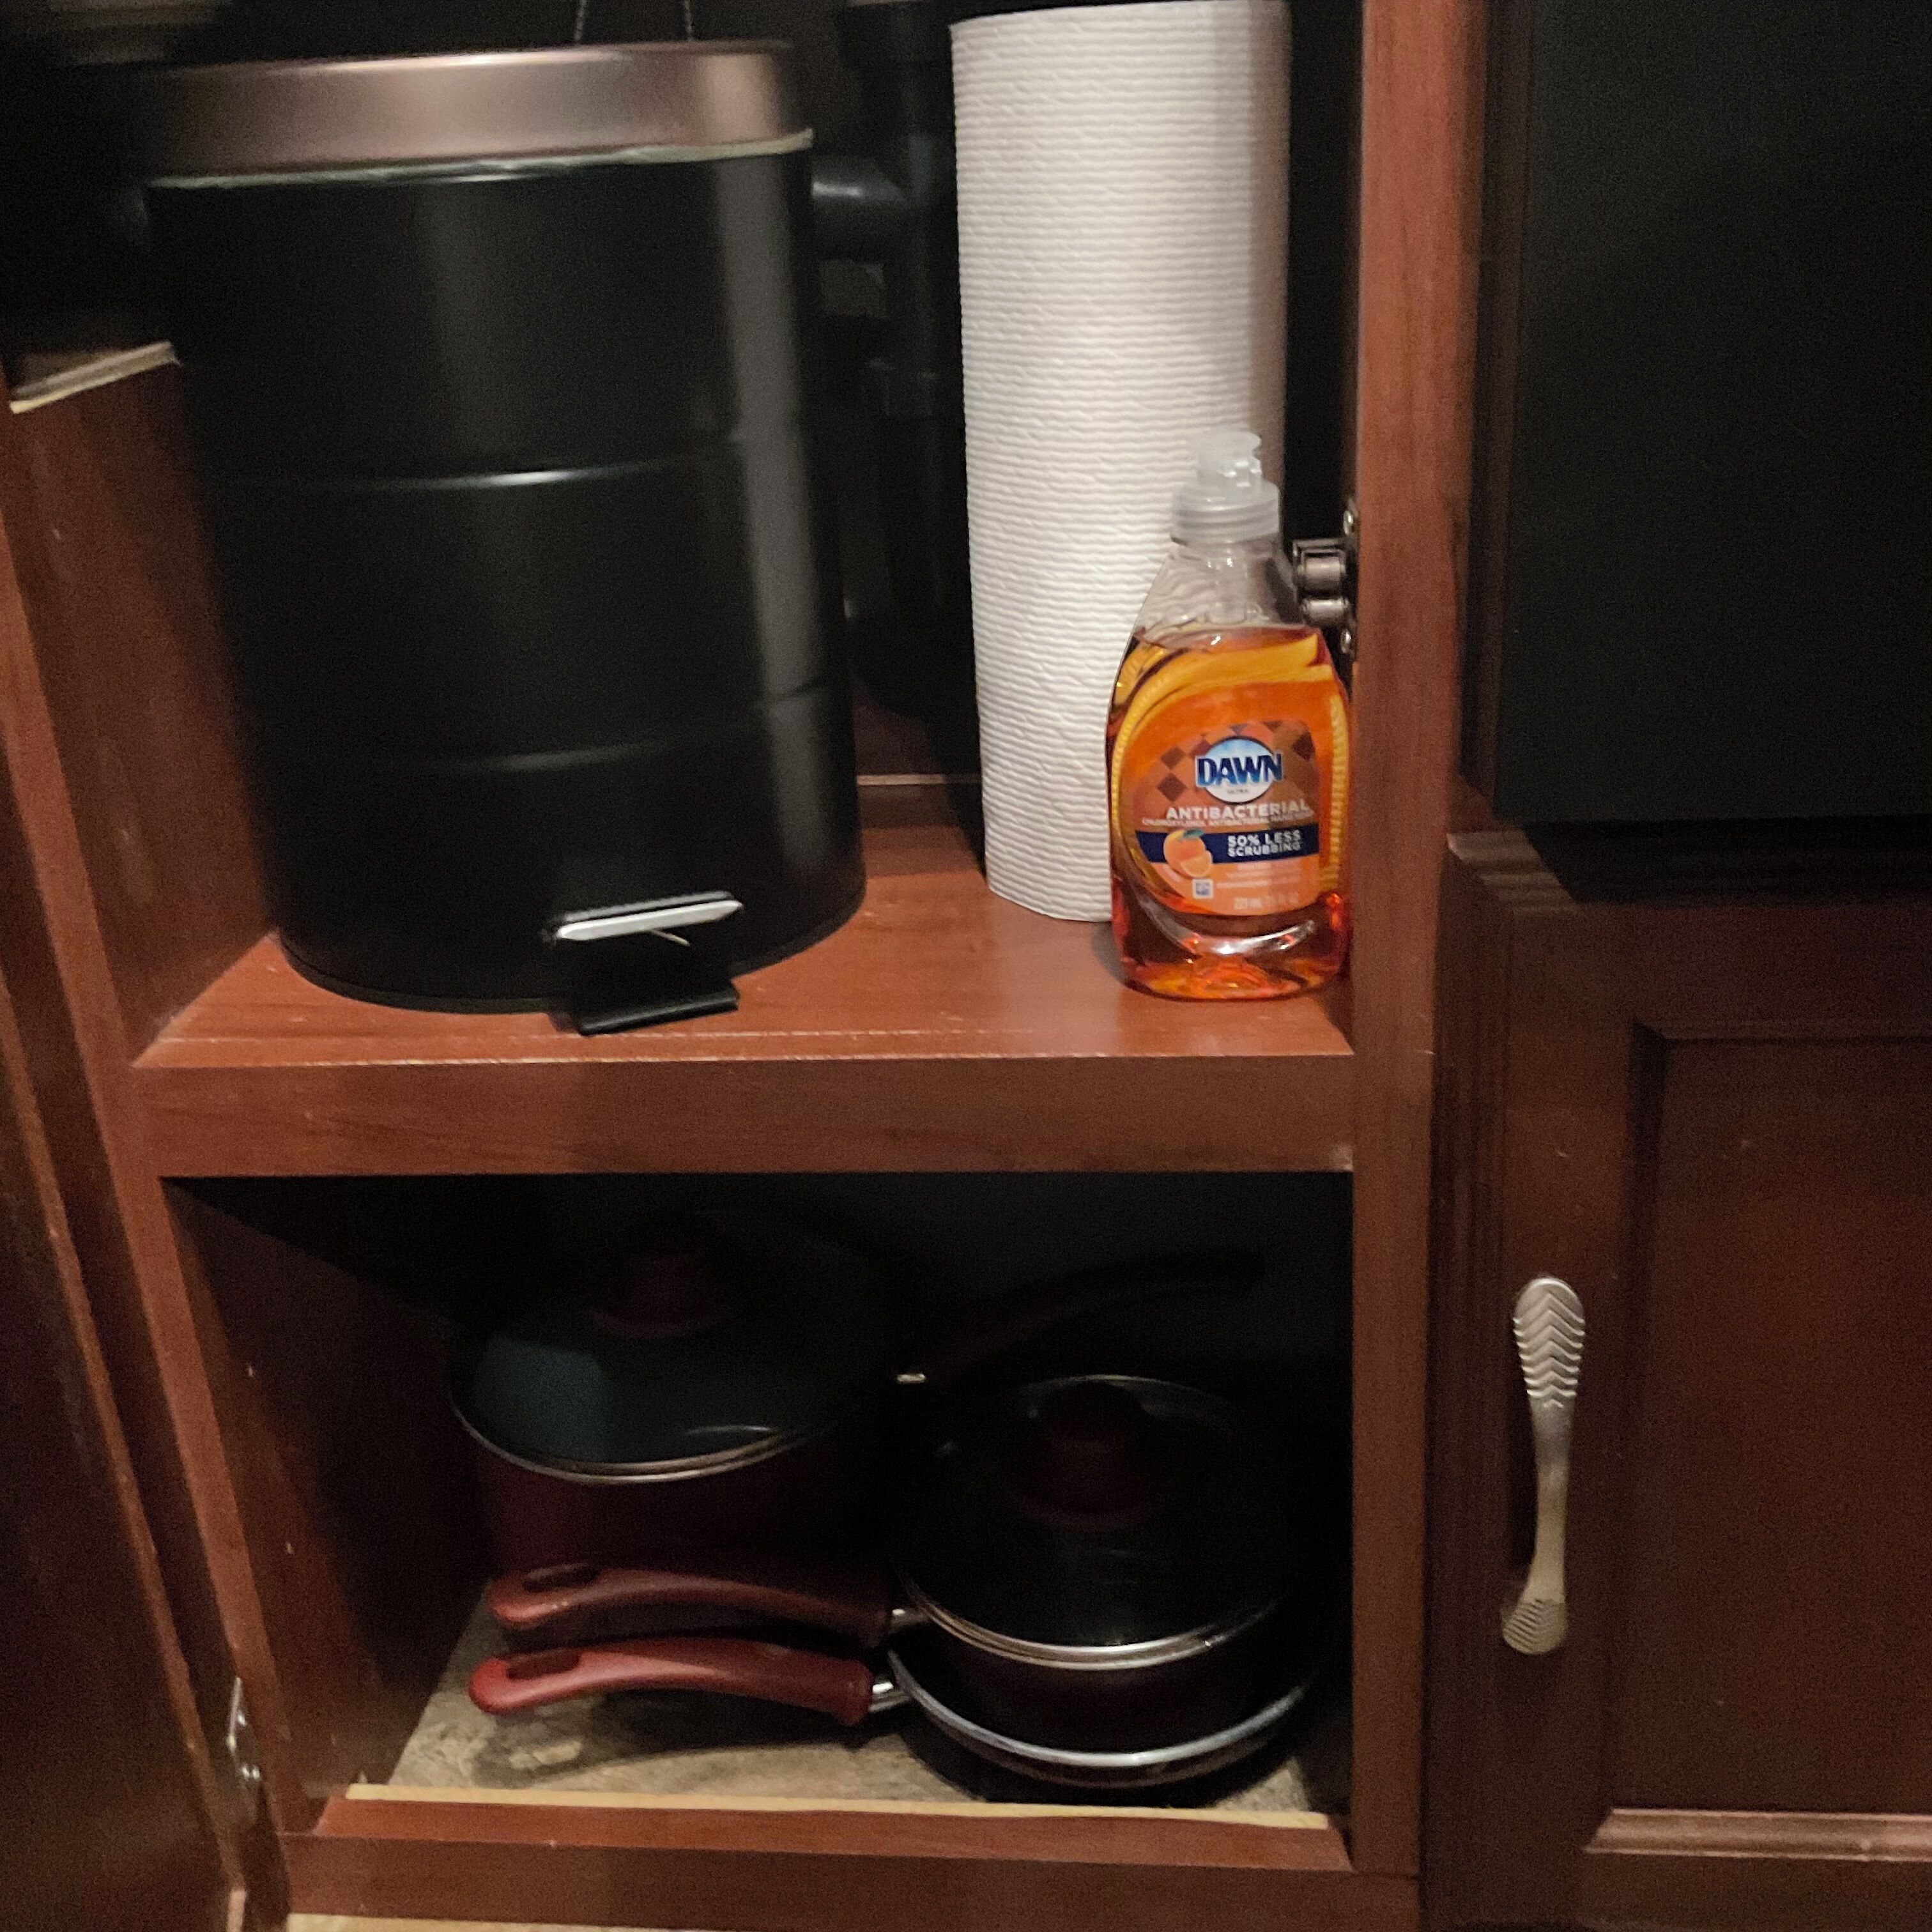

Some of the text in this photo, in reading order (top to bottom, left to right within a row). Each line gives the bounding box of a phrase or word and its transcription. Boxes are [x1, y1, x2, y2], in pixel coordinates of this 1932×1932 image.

[1197, 753, 1283, 786] DAWN
[1166, 799, 1310, 820] ANTIBACTERIAL
[1228, 830, 1301, 848] 50% LESS
[1228, 843, 1301, 857] SCRUBBING
